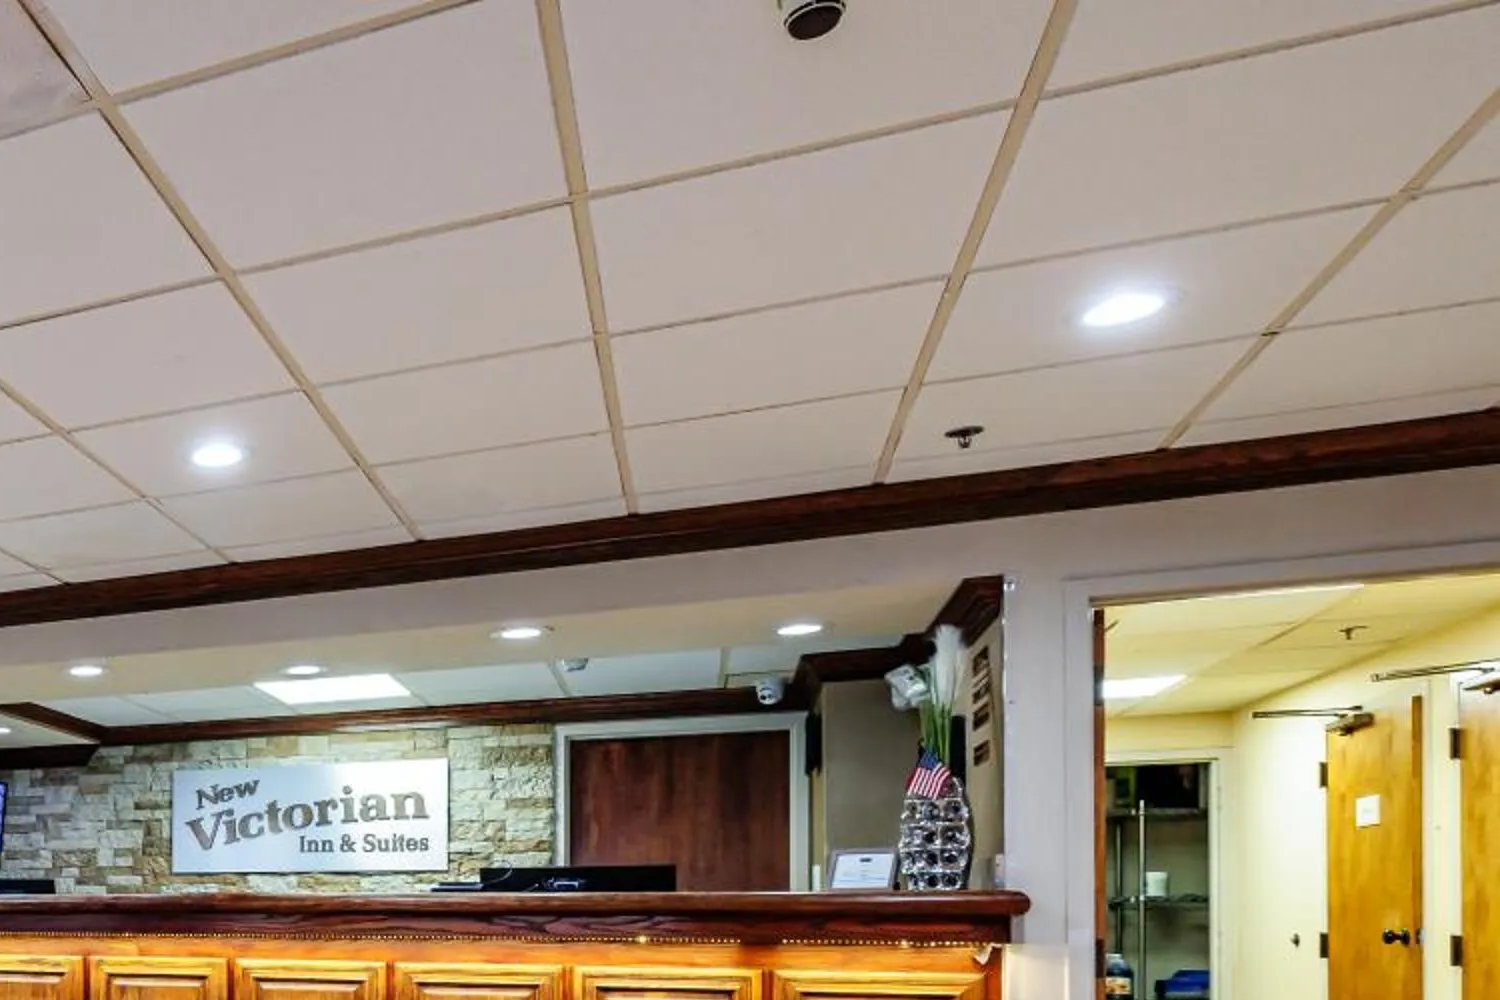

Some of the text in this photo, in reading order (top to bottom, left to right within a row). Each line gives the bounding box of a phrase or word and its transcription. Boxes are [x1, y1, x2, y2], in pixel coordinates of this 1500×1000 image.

[195, 779, 260, 810] New
[185, 785, 429, 850] Victorian
[299, 833, 429, 853] Inn & Suites
